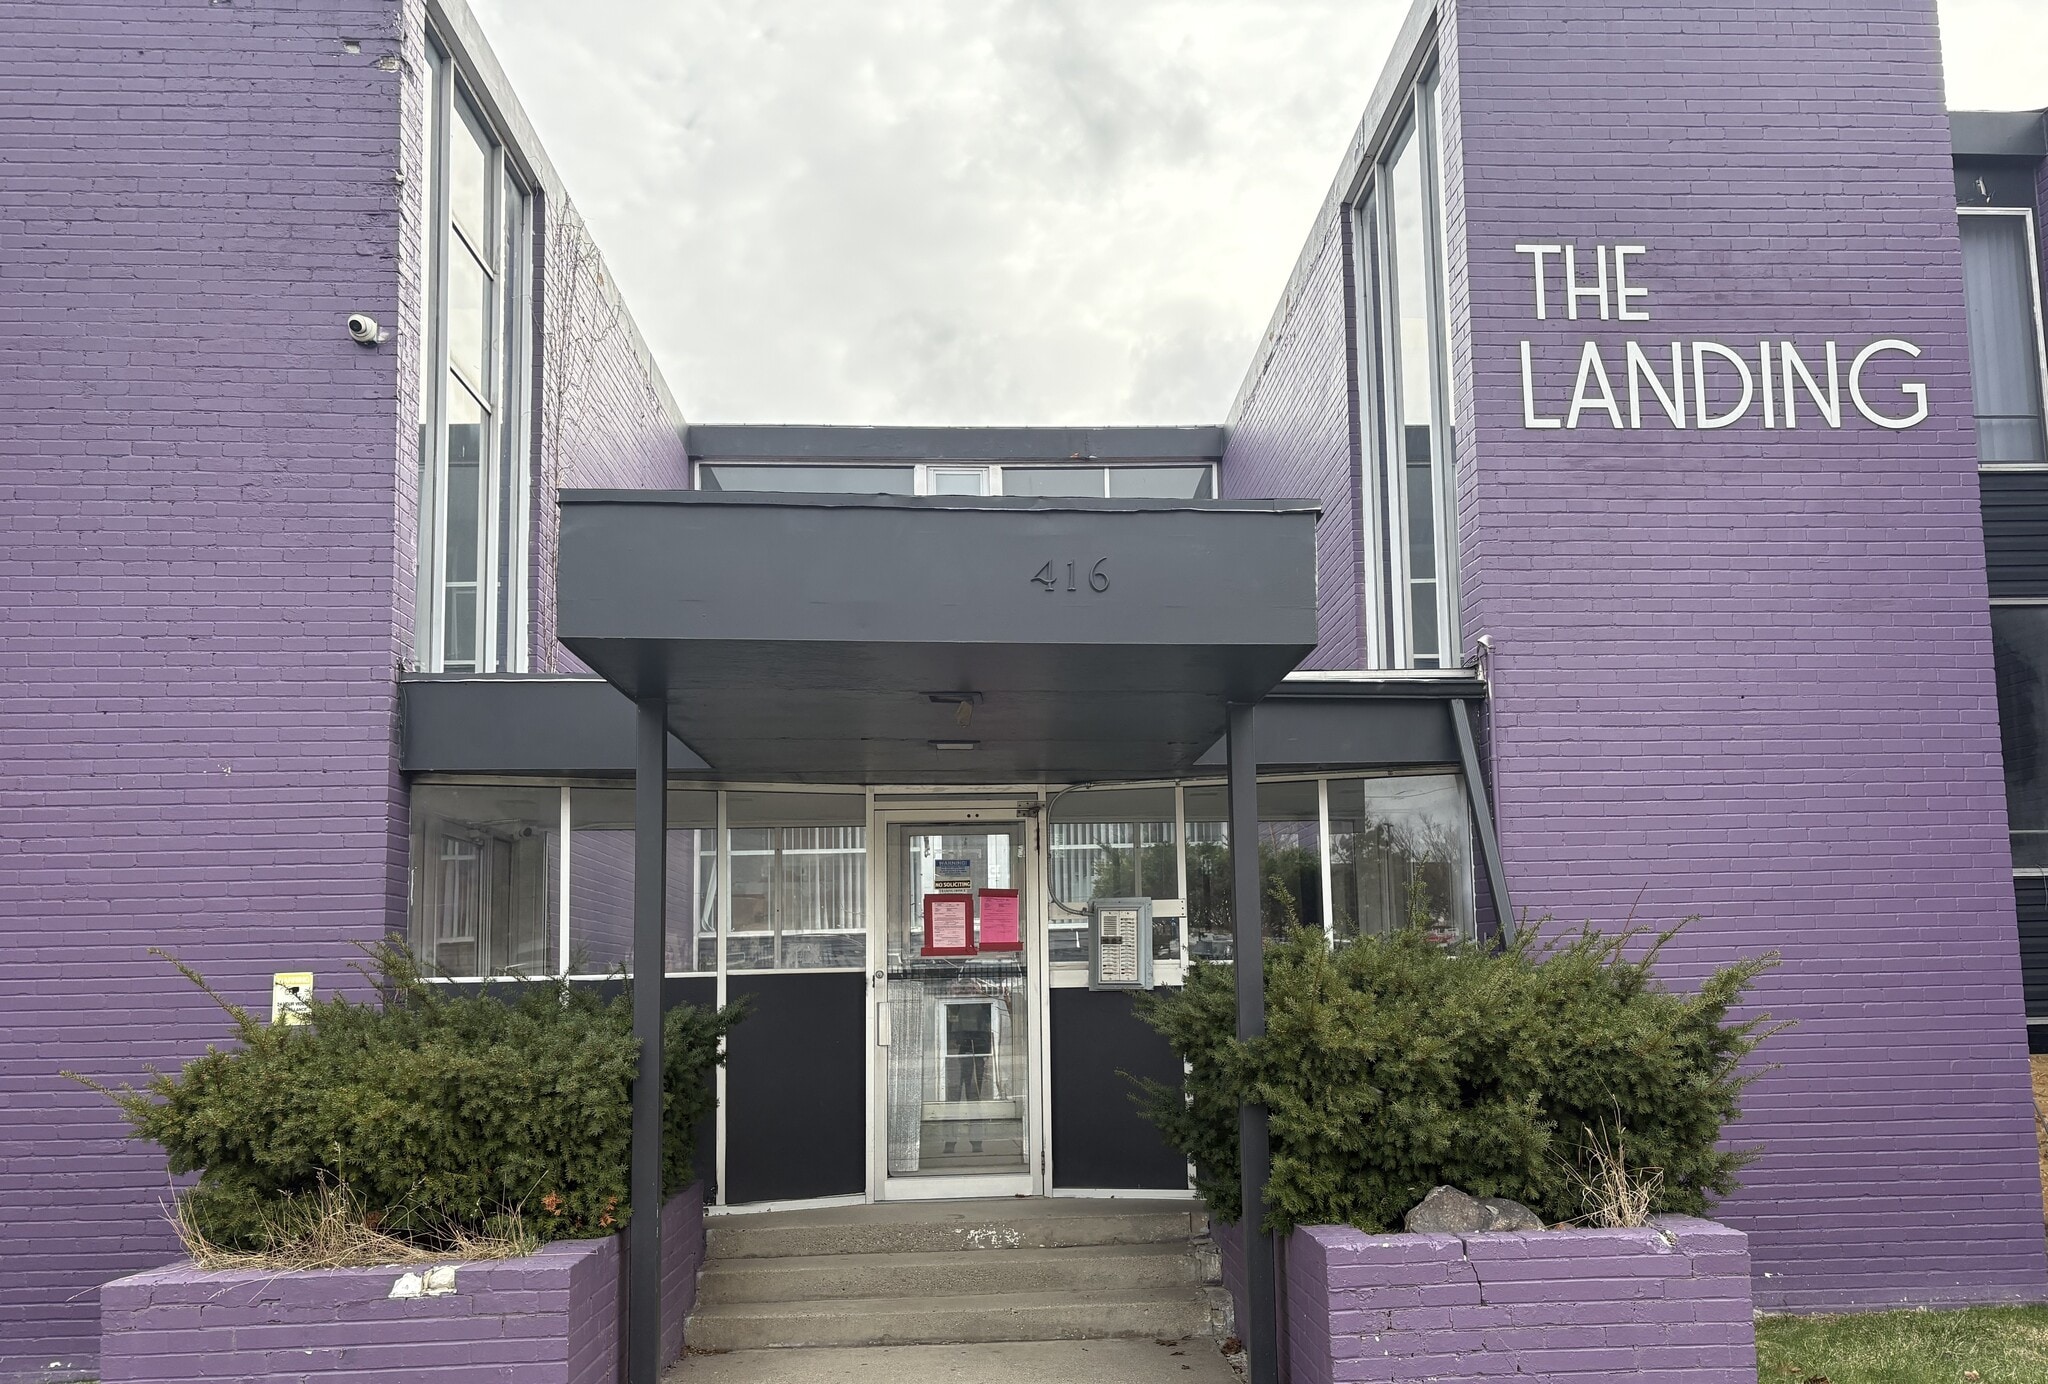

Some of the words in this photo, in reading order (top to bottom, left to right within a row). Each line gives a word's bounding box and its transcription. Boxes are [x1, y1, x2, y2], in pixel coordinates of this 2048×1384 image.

[1515, 244, 1650, 321] THE
[1519, 339, 1929, 431] LANDING
[1030, 556, 1110, 593] 416
